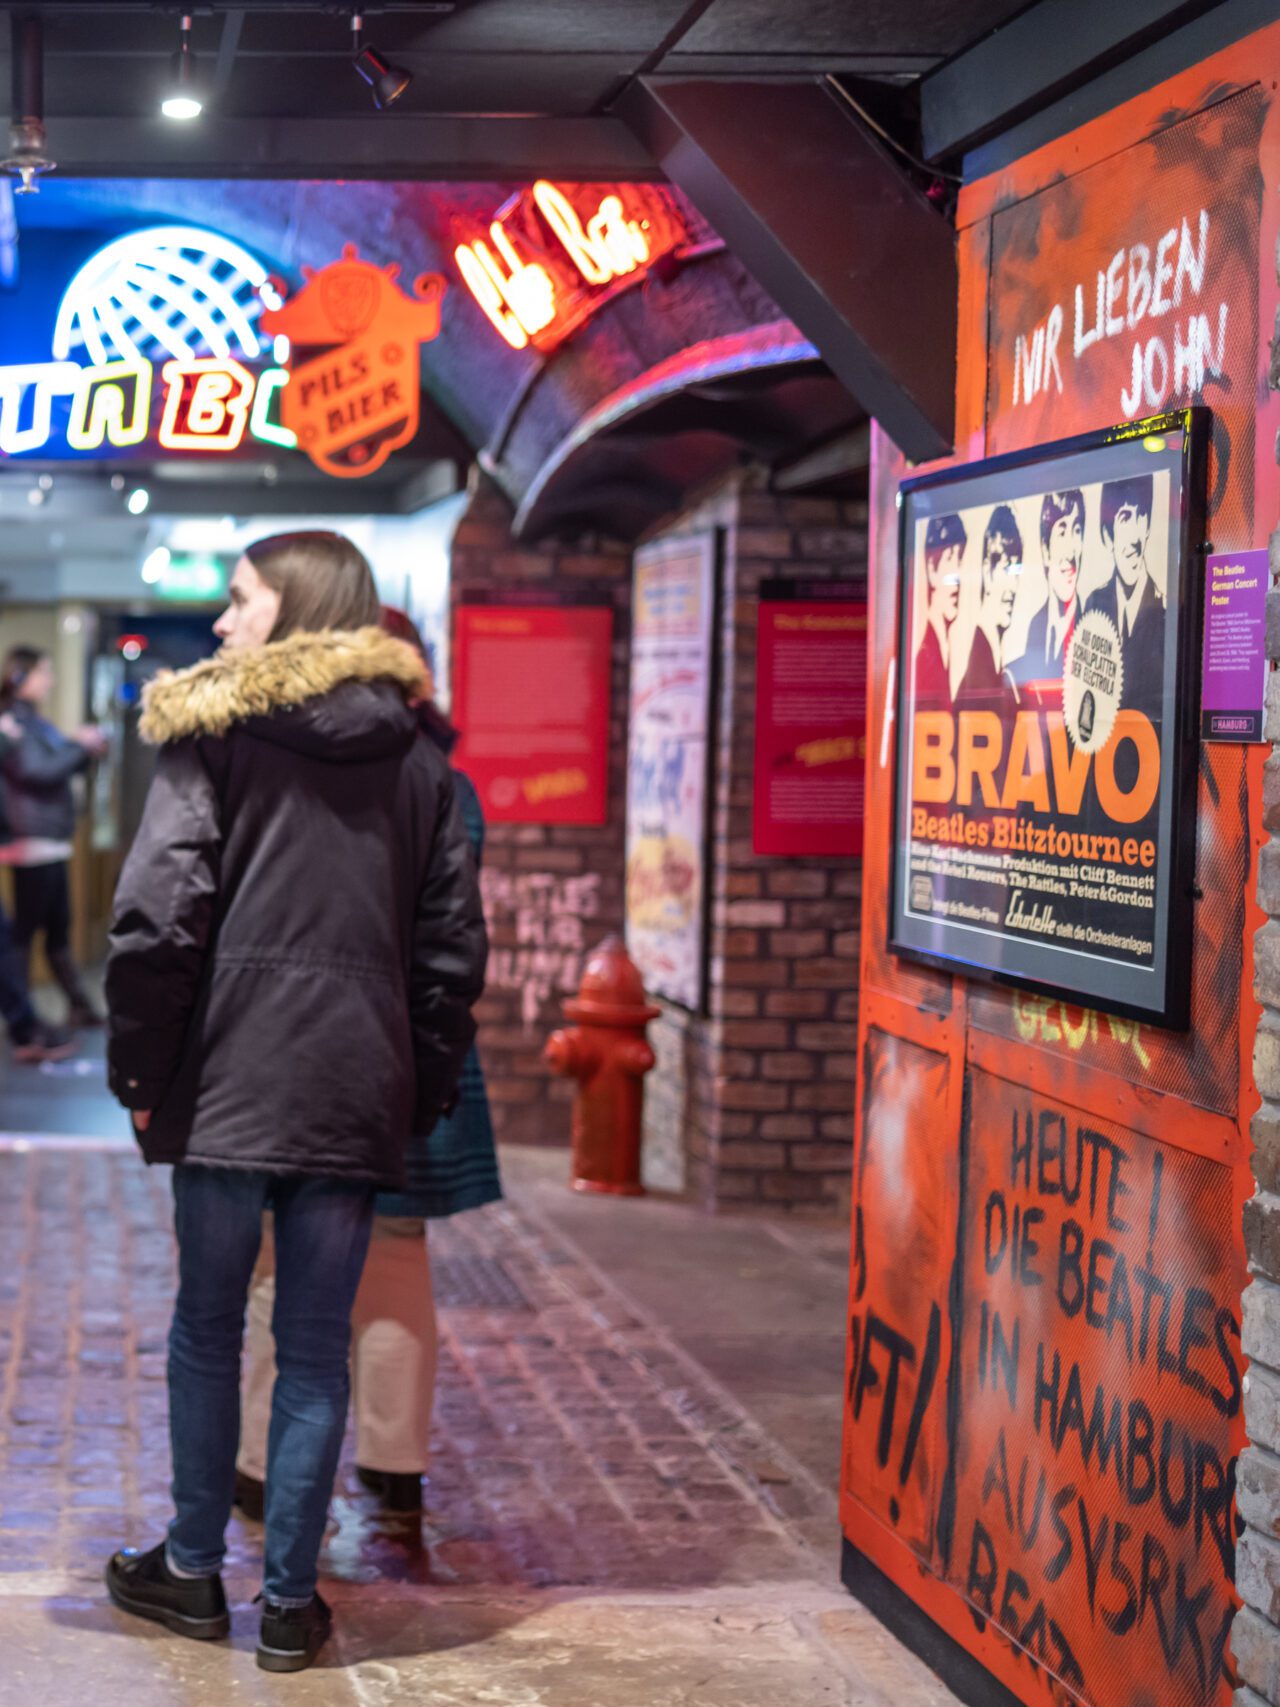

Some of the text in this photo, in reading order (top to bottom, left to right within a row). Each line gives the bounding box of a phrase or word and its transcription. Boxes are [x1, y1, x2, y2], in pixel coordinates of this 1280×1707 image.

[1073, 208, 1209, 359] LIEBEN
[299, 353, 369, 408] PILS
[1120, 302, 1228, 418] JOHN
[326, 380, 401, 435] BIER
[1212, 566, 1223, 577] The
[1217, 719, 1248, 730] HAMBURG
[912, 709, 1161, 825] BRAVO
[911, 807, 1156, 868] Beatles Blitztournee
[1002, 854, 1059, 876] Produktion
[1059, 863, 1080, 880] mit
[1080, 865, 1106, 885] Cliff
[1106, 869, 1155, 891] Bennett
[1008, 872, 1027, 887] The
[1028, 874, 1068, 898] Rattles,
[1069, 881, 1154, 909] Peter&Gordon
[1073, 924, 1086, 941] die
[1086, 926, 1153, 956] Orchesteranlagen
[984, 1189, 1046, 1286] DIE
[1057, 1216, 1241, 1419] BEATLES
[978, 1299, 1020, 1411] IN
